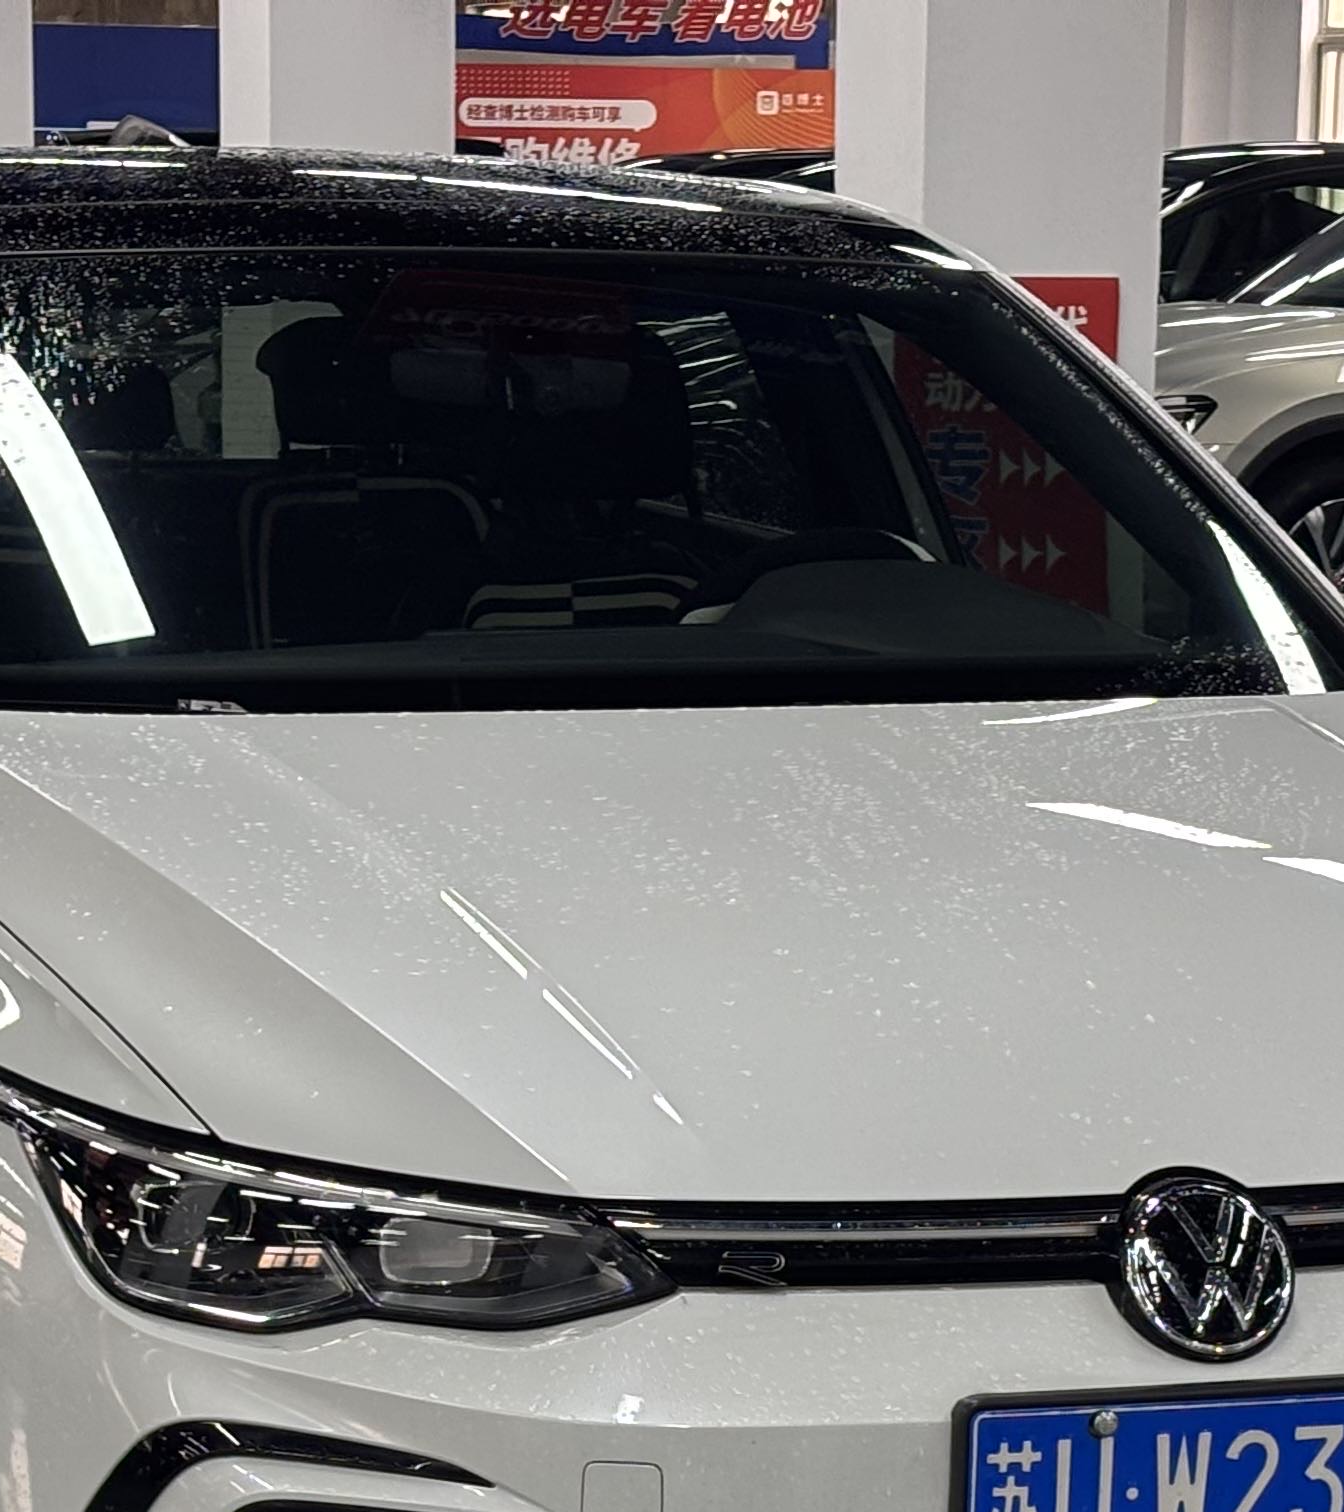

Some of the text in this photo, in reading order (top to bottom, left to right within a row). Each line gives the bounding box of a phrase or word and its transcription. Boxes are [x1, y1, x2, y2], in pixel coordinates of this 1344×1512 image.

[467, 104, 622, 123] 经查博士检测购车可享
[718, 1251, 788, 1287] R
